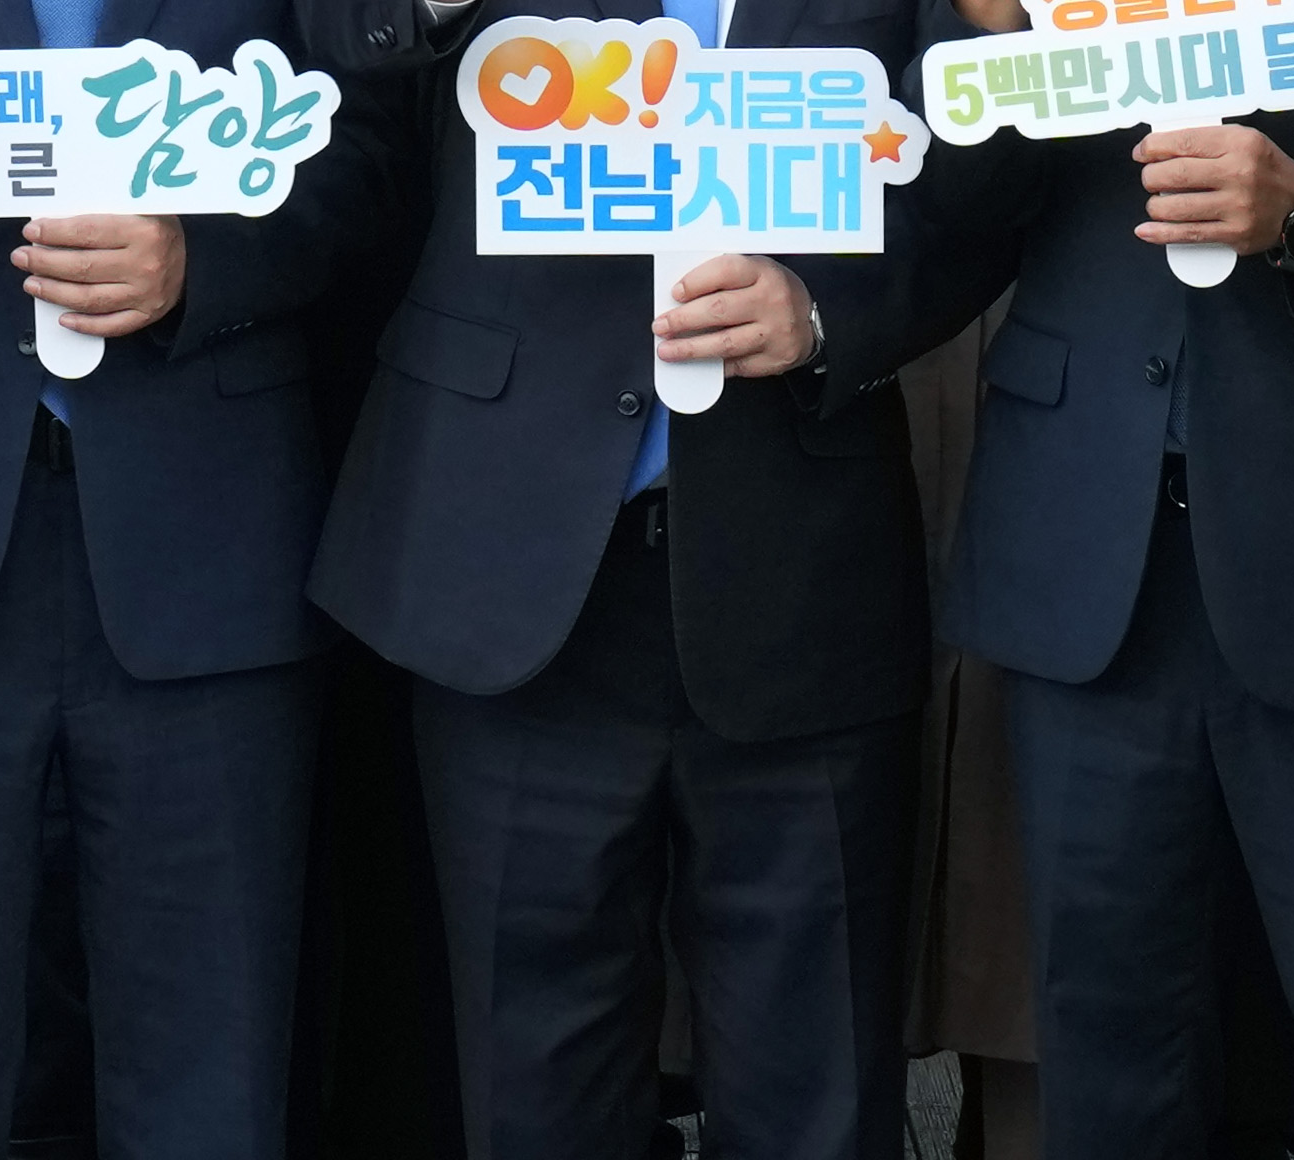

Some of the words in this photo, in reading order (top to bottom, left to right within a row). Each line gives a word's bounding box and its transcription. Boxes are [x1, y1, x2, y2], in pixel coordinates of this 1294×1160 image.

[478, 36, 679, 131] OK!
[684, 70, 868, 130] 지금은
[943, 27, 1246, 128] 5백만시대
[7, 142, 58, 198] 큰
[81, 57, 322, 200] 담양
[496, 142, 863, 232] 전남시대
